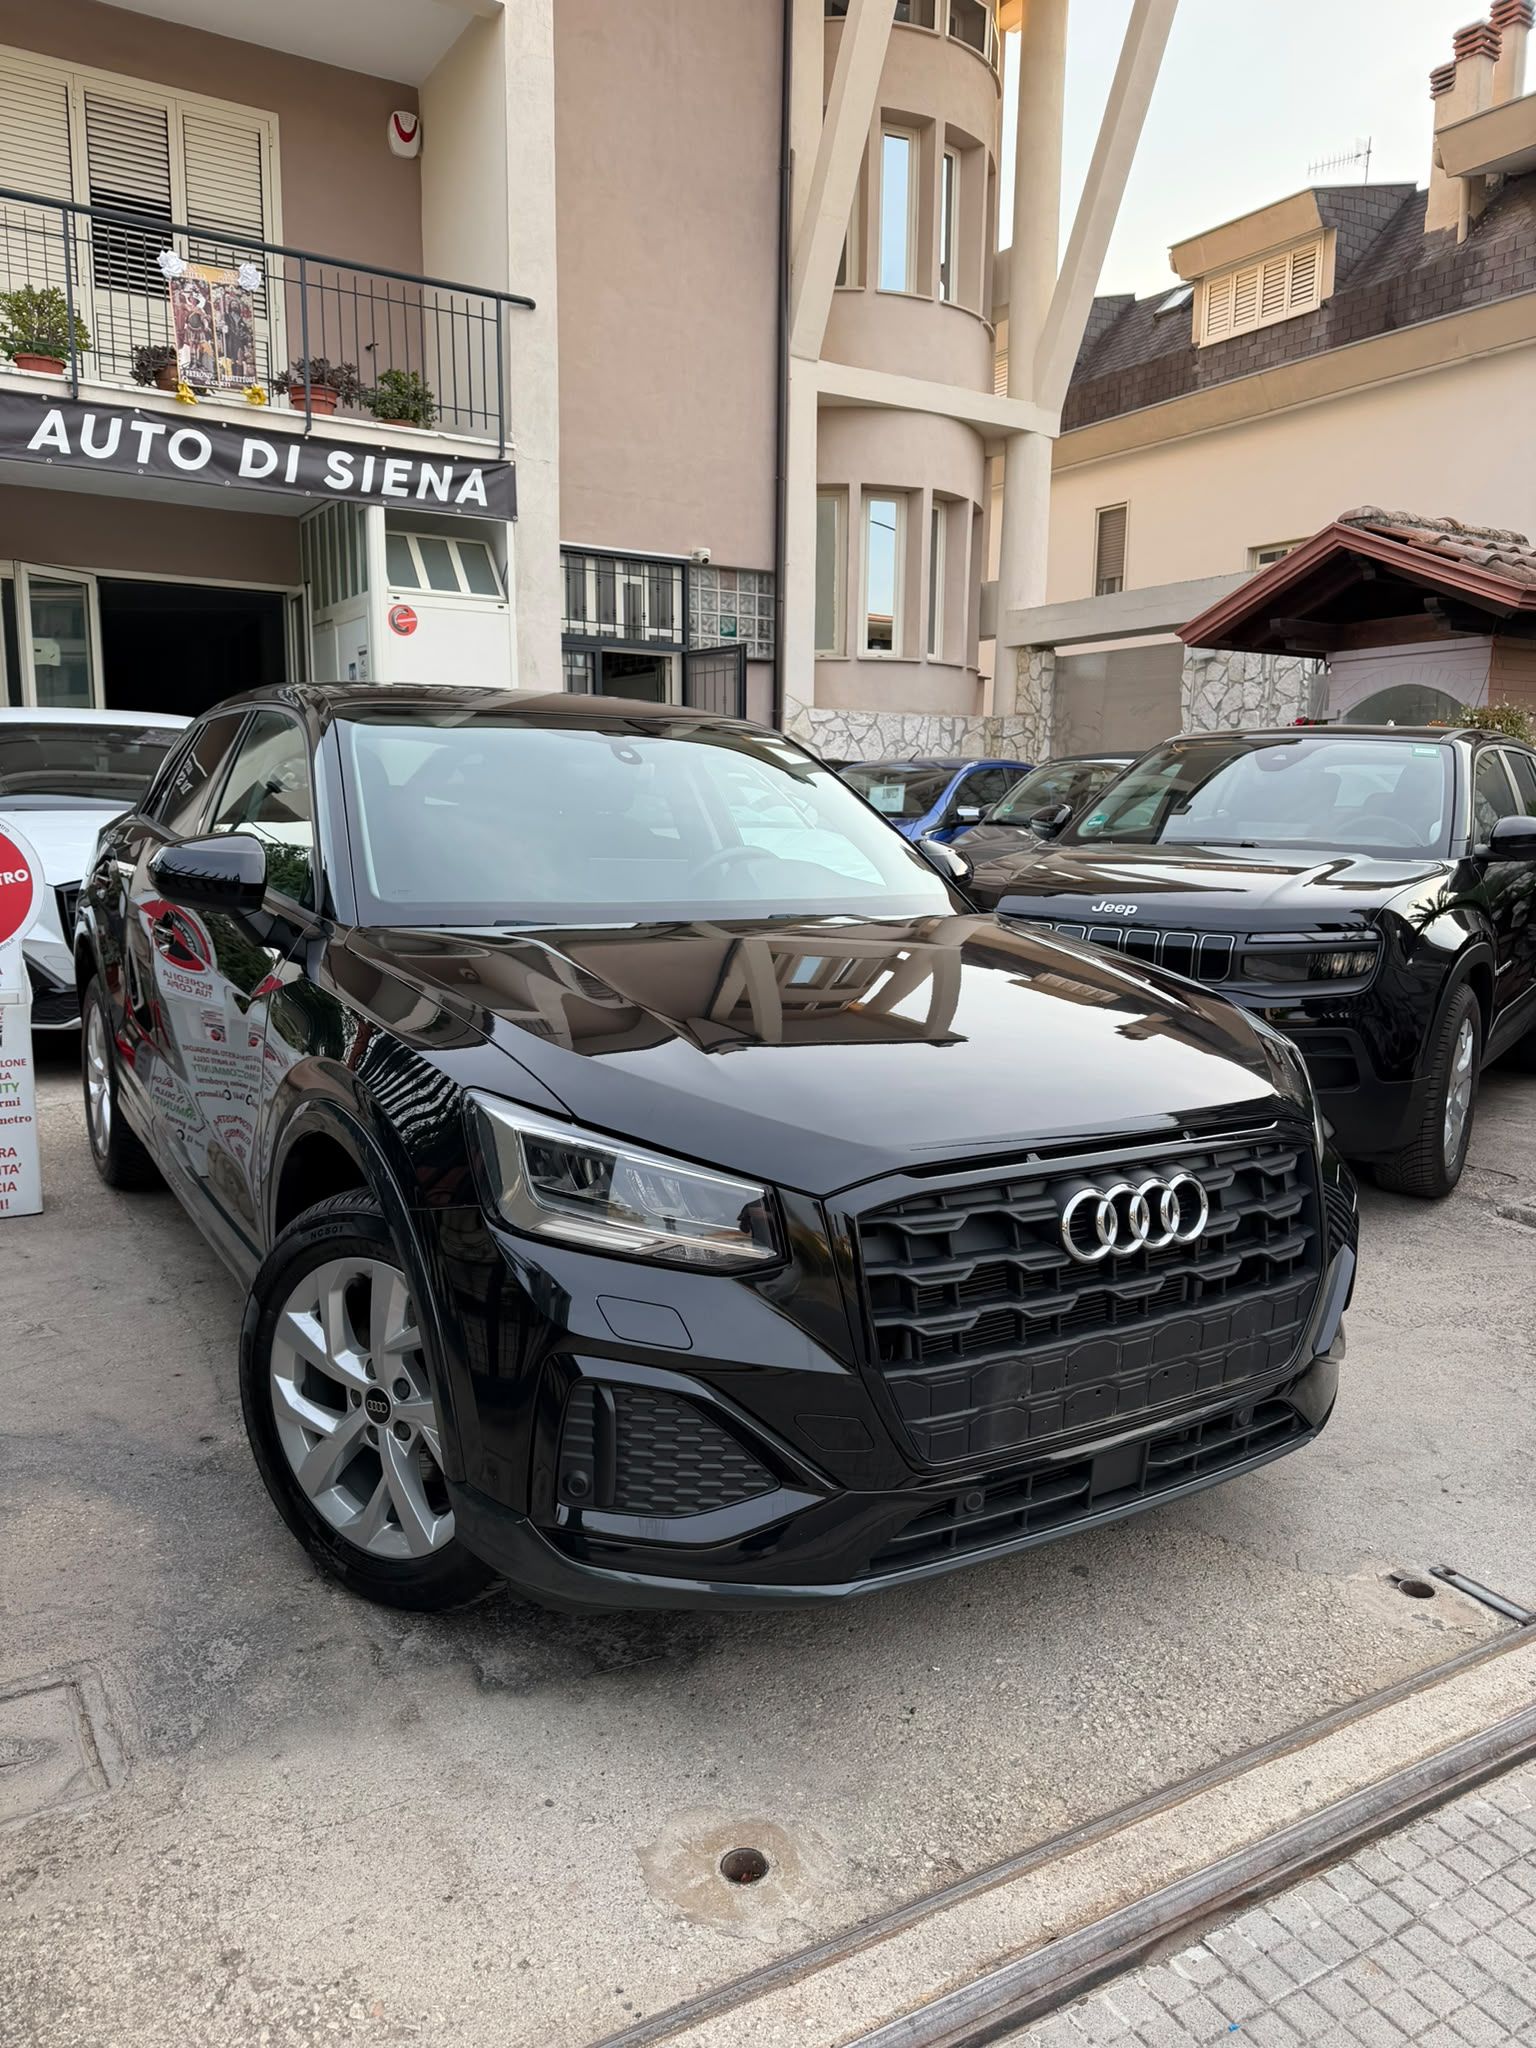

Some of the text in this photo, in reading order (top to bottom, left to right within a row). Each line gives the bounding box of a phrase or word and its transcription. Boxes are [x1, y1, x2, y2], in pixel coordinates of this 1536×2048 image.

[27, 409, 488, 507] AUTO DI SIENA
[1091, 900, 1138, 916] Jeep
